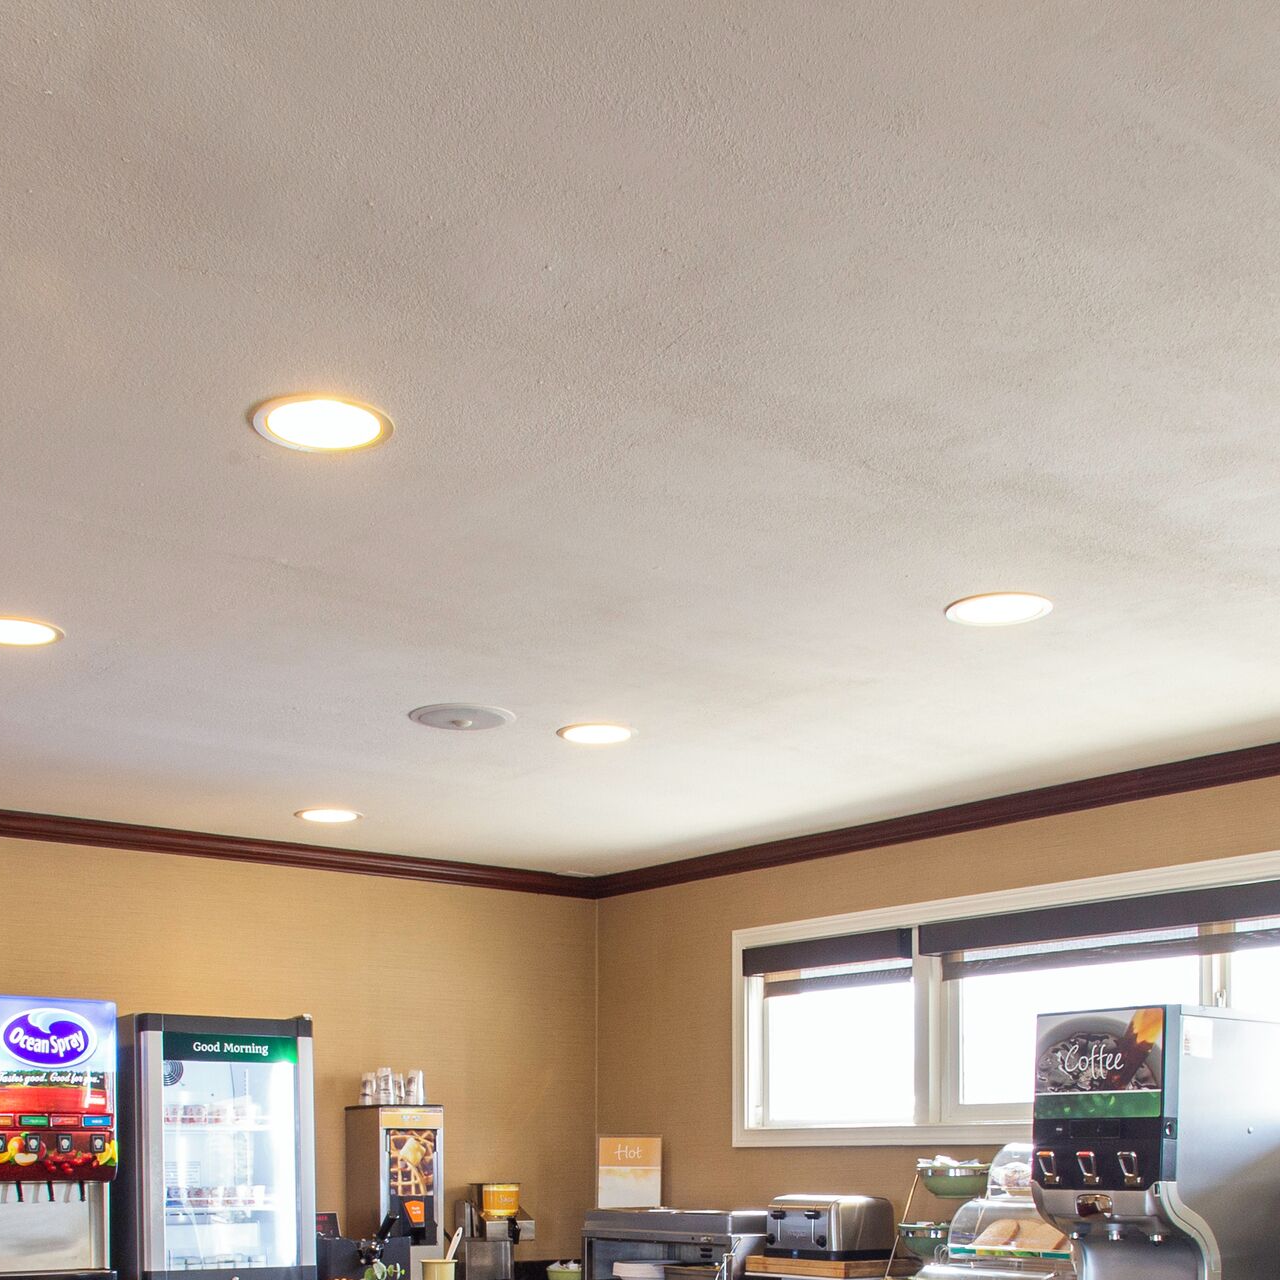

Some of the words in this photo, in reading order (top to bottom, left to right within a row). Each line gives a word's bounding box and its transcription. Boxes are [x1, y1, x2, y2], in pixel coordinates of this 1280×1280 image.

[9, 1027, 50, 1053] Ocean
[49, 1030, 85, 1057] Spray
[193, 1042, 221, 1052] Good
[223, 1043, 269, 1057] Morning
[1064, 1043, 1124, 1080] Coffee
[23, 1073, 48, 1086] good.
[50, 1072, 71, 1083] Good
[70, 1073, 83, 1085] for
[614, 1144, 642, 1161] Hot
